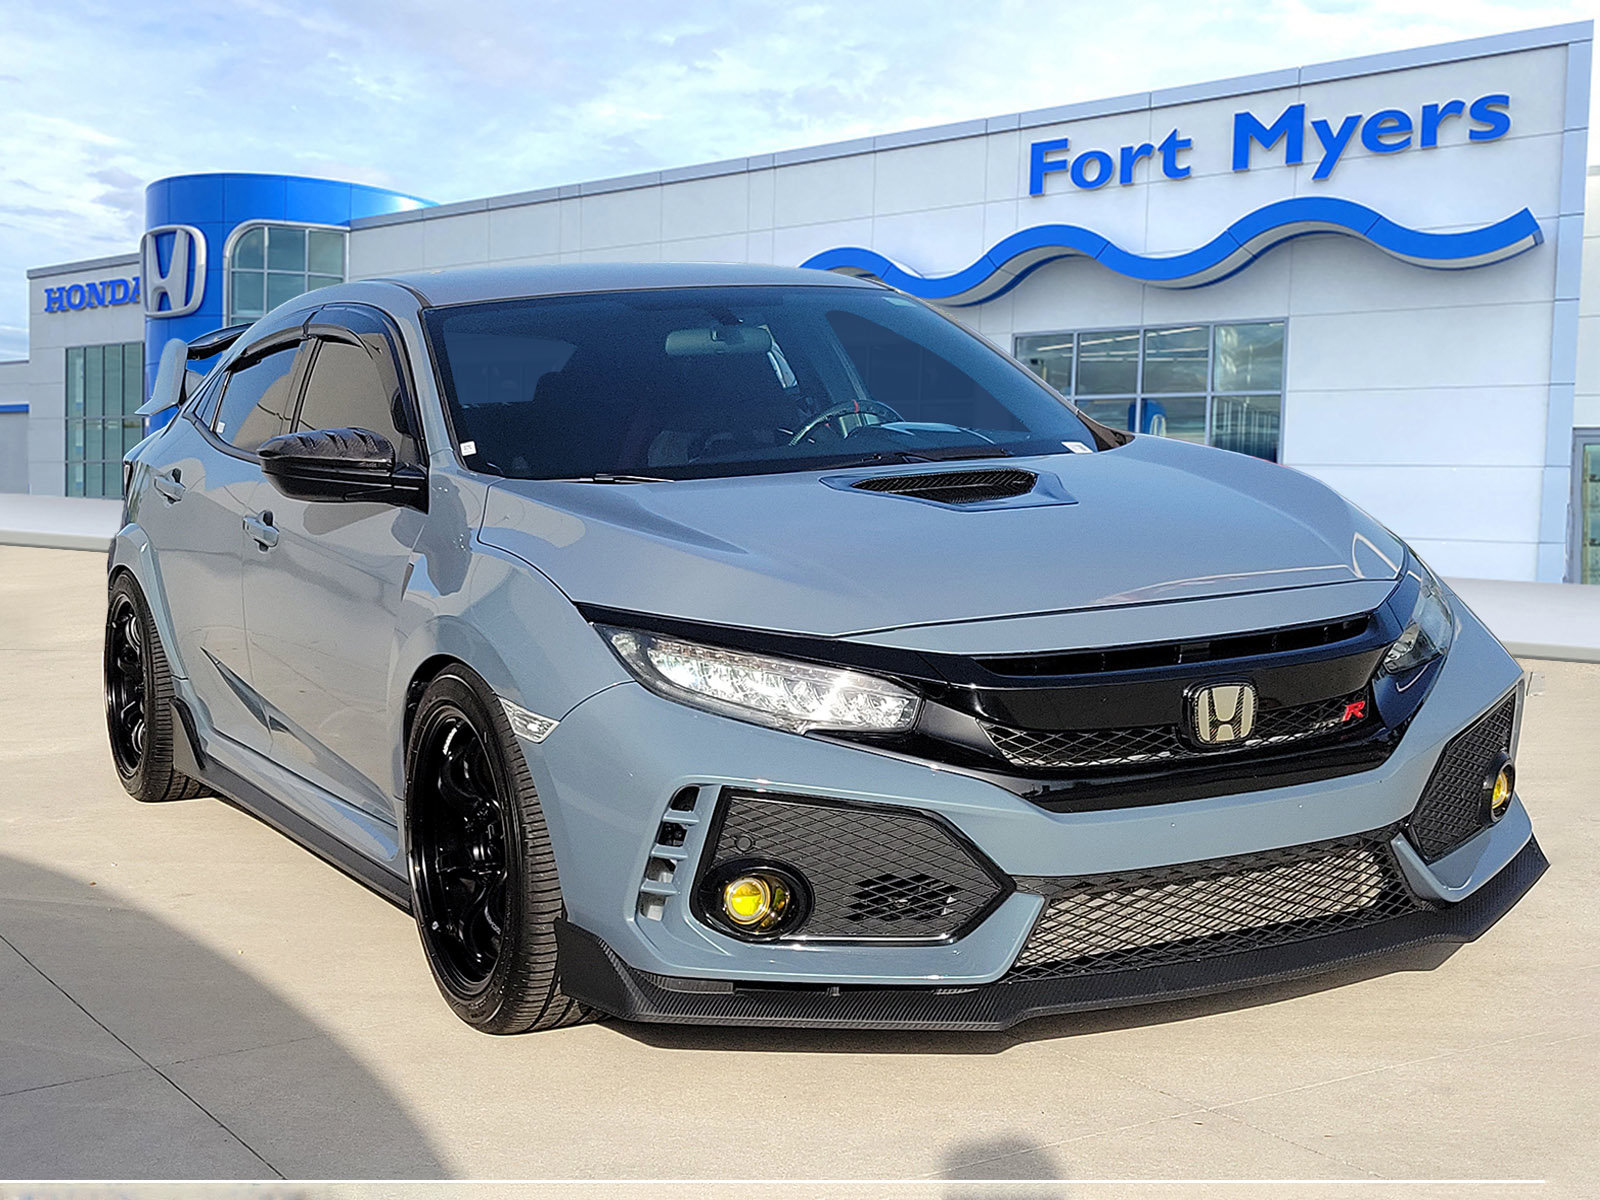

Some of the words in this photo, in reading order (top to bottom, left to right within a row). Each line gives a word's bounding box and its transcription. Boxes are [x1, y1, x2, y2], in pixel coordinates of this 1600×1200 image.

[1028, 127, 1193, 196] Fort
[1232, 93, 1511, 181] Myers
[1341, 700, 1366, 722] R
